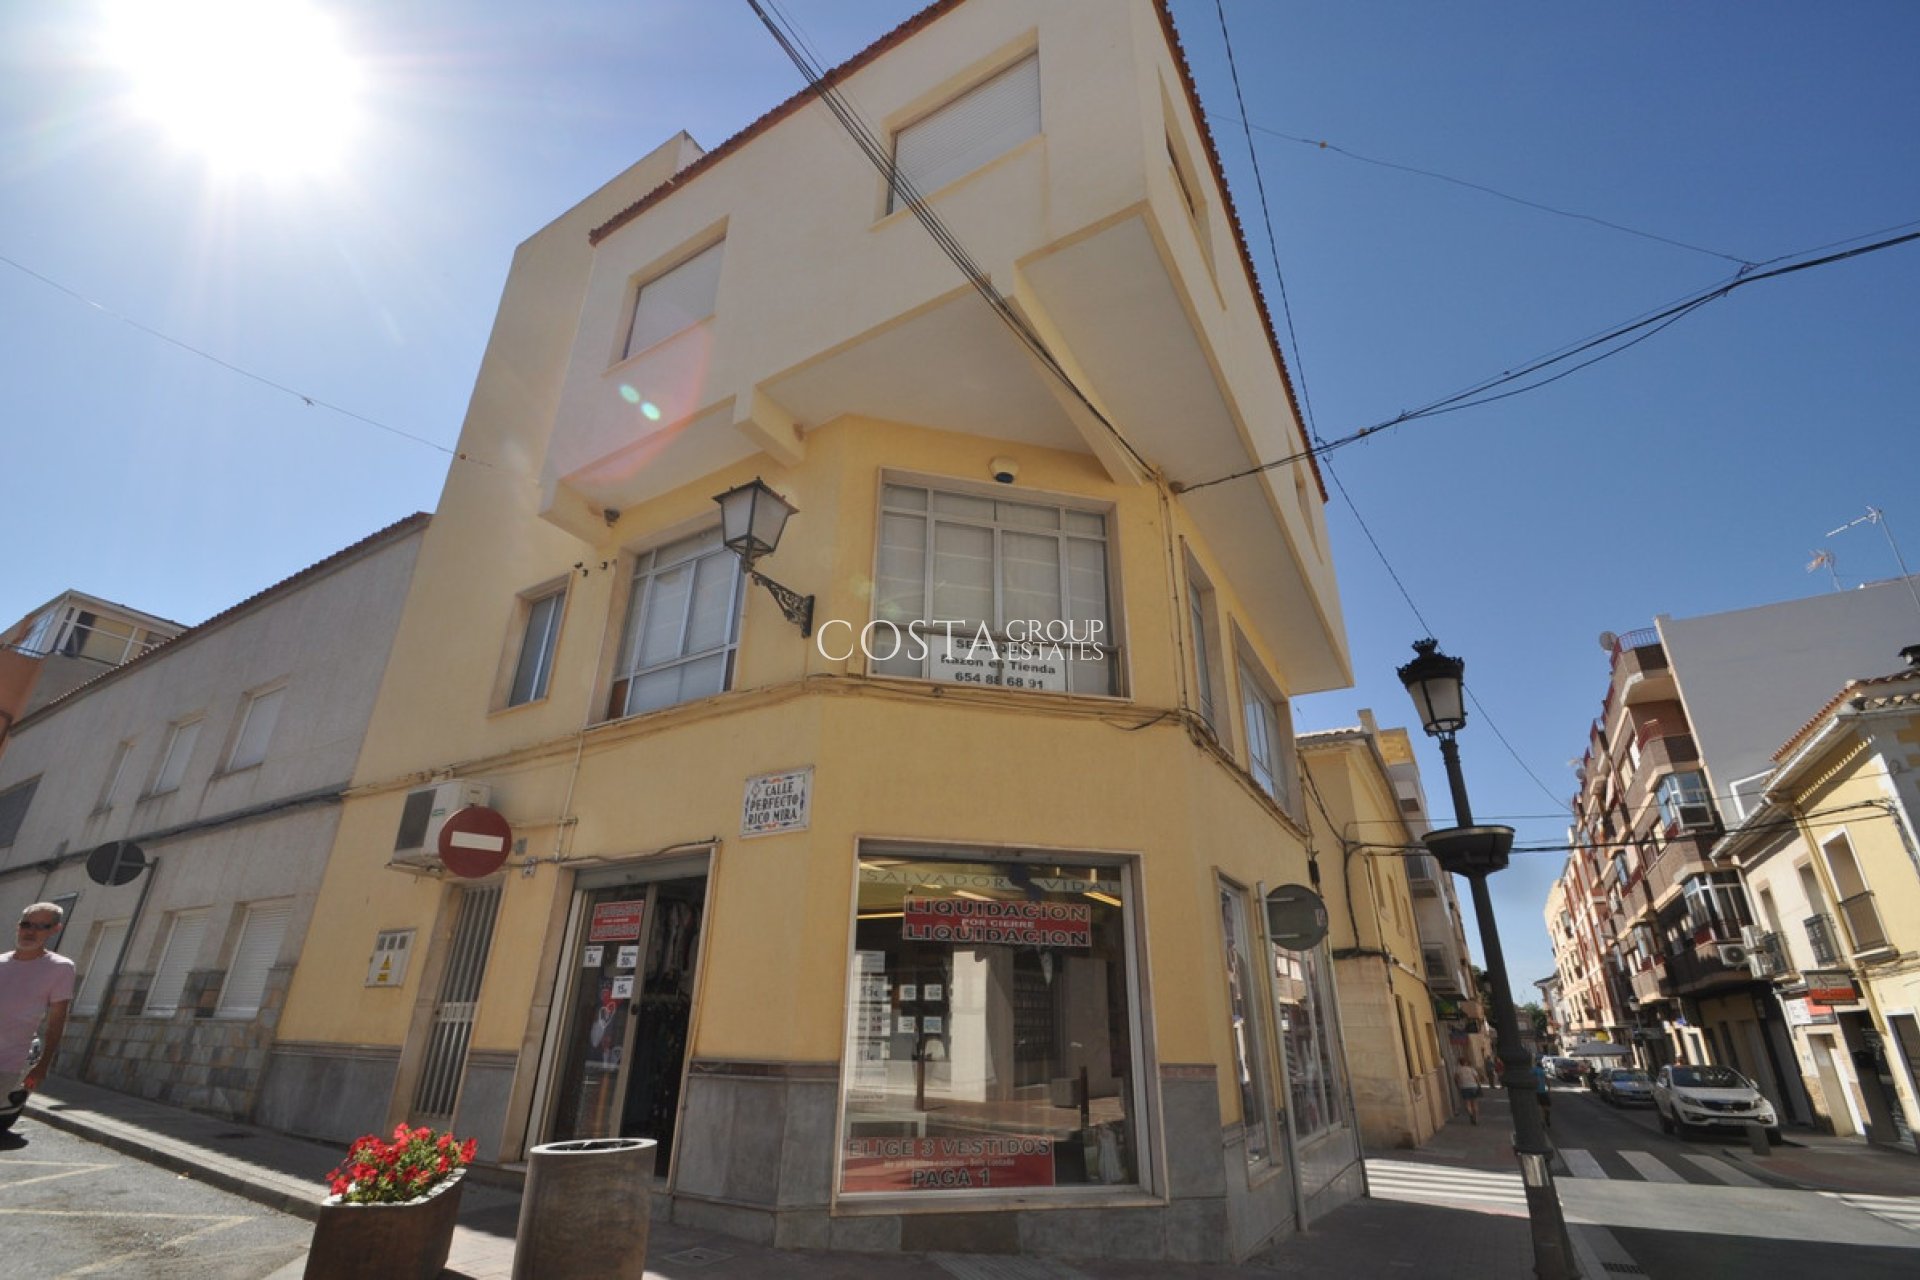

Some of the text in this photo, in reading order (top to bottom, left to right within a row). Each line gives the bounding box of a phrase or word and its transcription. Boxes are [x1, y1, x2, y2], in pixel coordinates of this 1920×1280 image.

[979, 642, 1040, 655] AQUIA
[1010, 662, 1056, 674] Tienda
[955, 671, 981, 682] 654
[1006, 675, 1024, 687] 68
[1028, 678, 1043, 689] 91
[765, 781, 794, 796] CALLE
[749, 794, 799, 812] PERFECTO
[866, 871, 1005, 888] SALVADOR
[907, 899, 1088, 921] LIQUIDACION
[962, 918, 1035, 928] POR CIERRE
[906, 924, 1089, 946] LIQUIDACION
[848, 1138, 1050, 1157] ELIGE 3 VESTIDOS
[911, 1168, 991, 1187] PAGA 1
